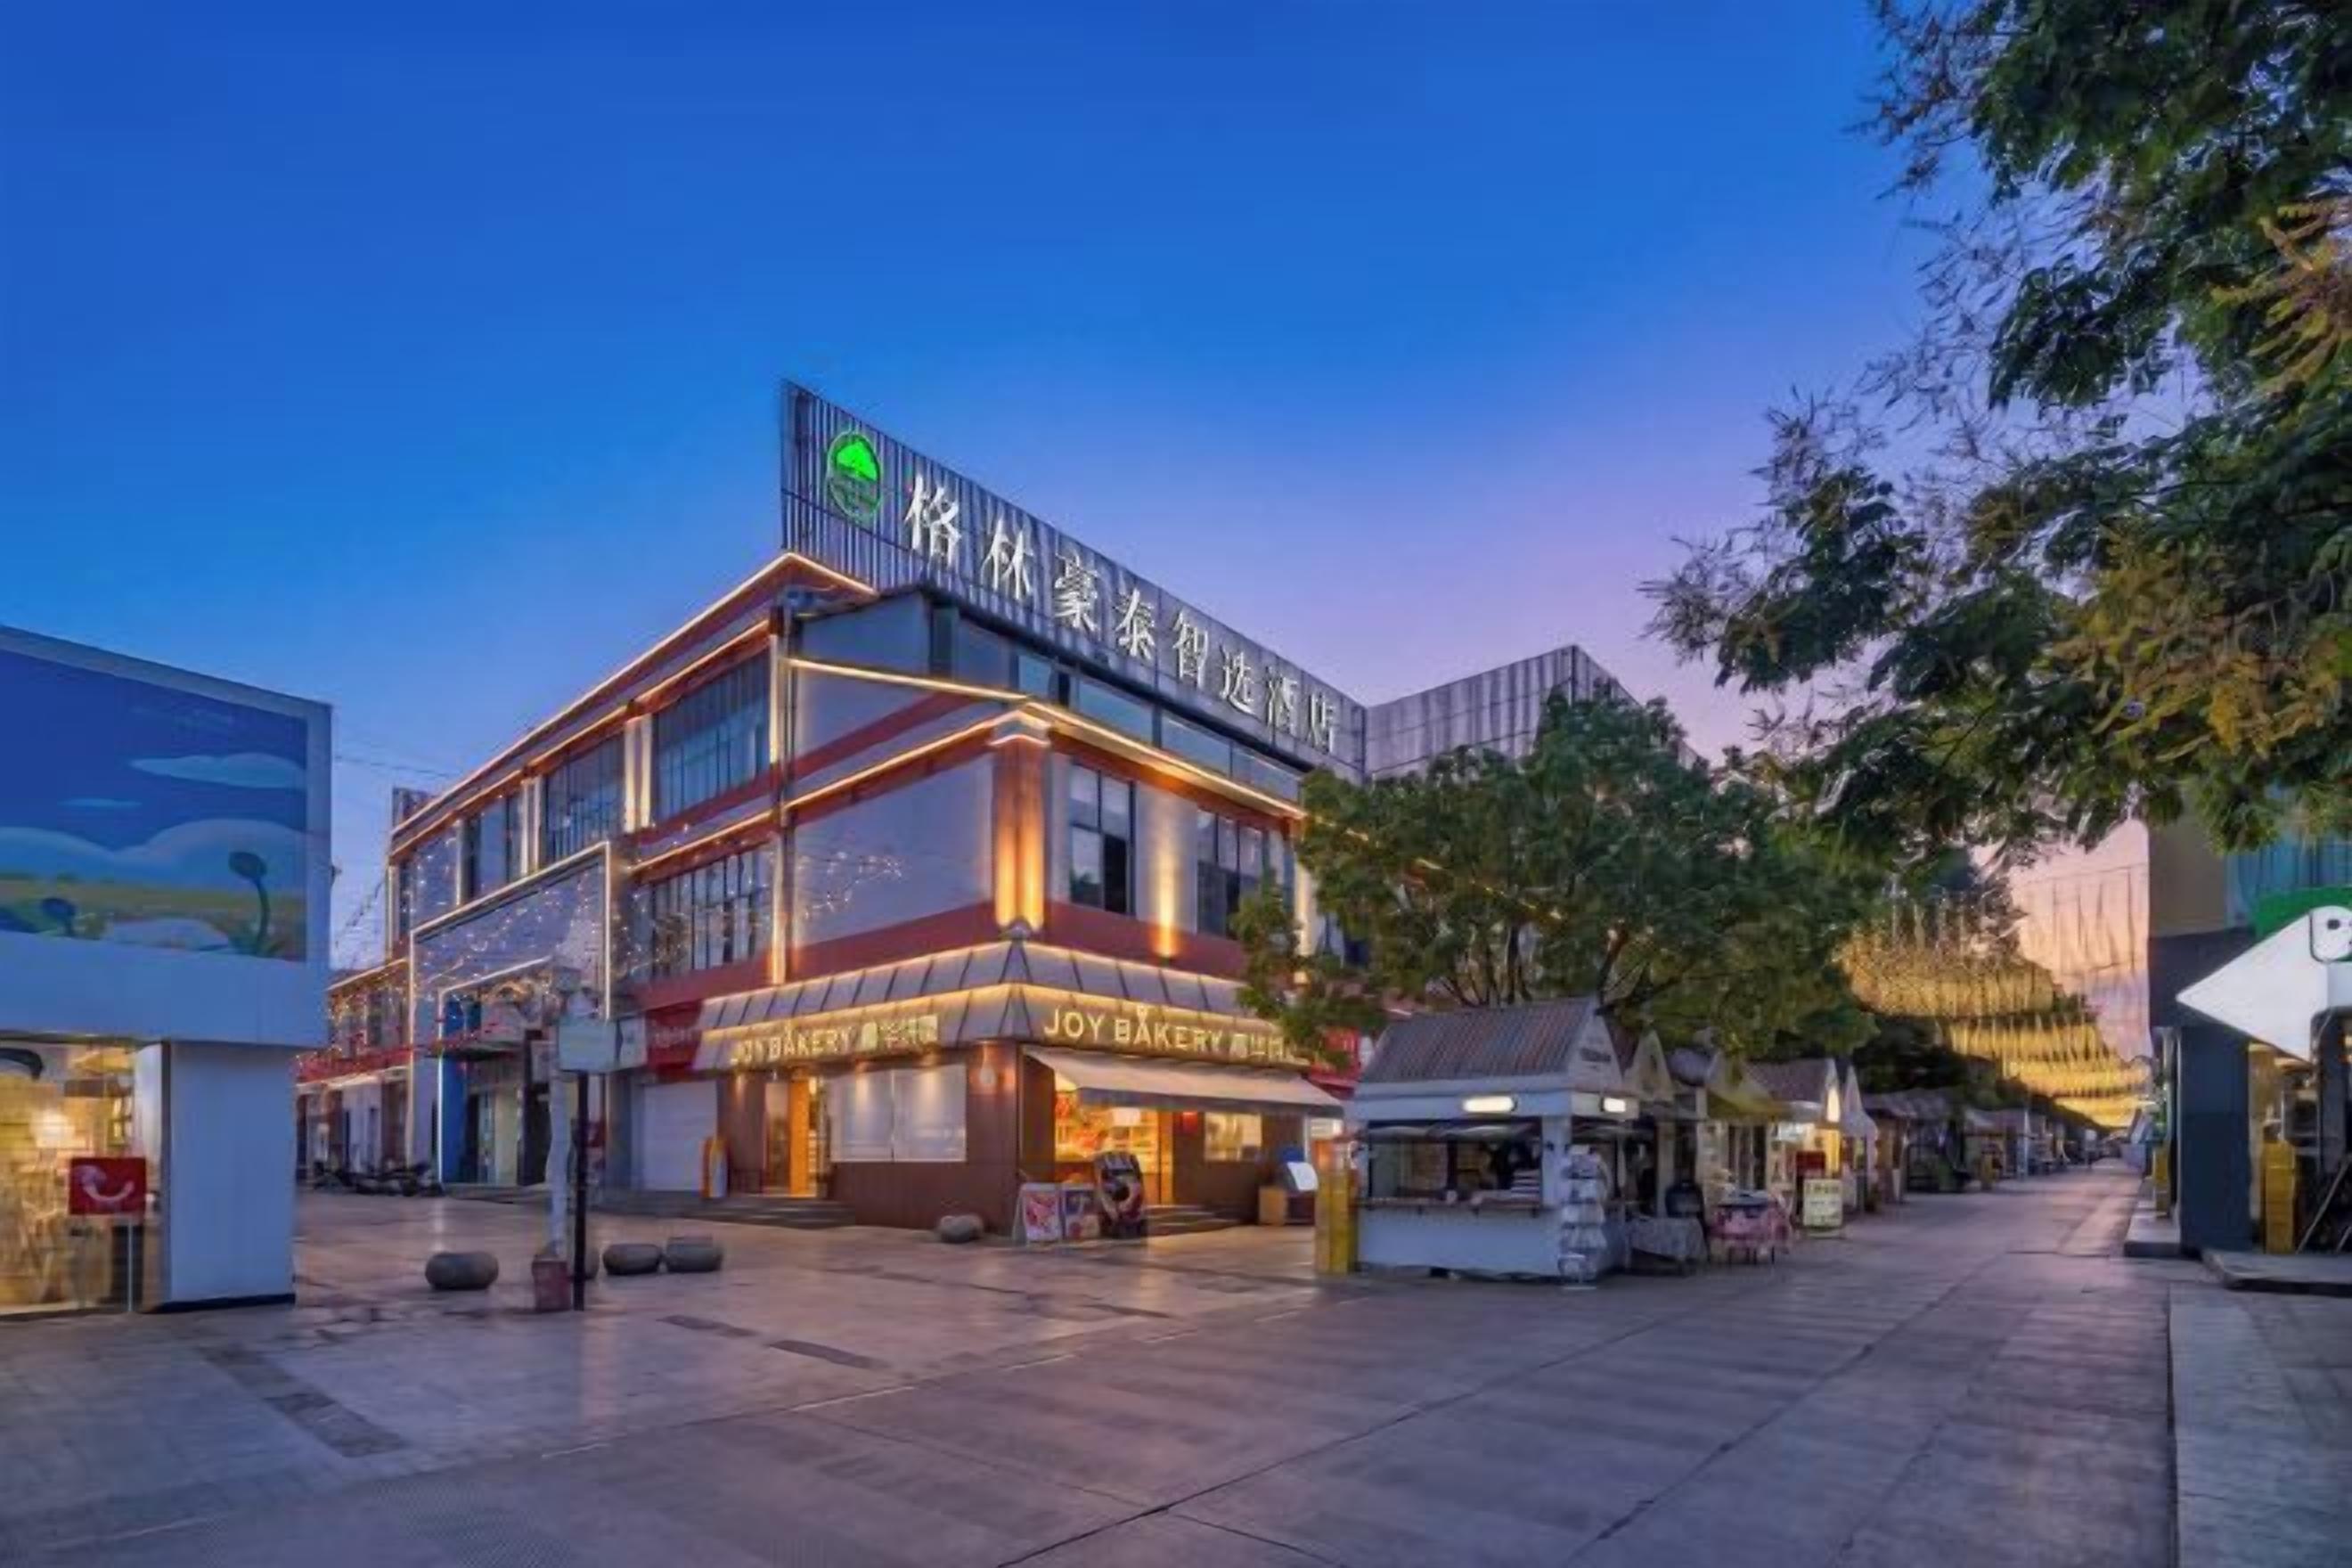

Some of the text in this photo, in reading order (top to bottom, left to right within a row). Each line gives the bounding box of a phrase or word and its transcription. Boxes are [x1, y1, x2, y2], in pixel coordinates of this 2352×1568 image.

[903, 474, 1335, 754] 格林豪泰智选酒店
[1043, 1006, 1107, 1041] JOY
